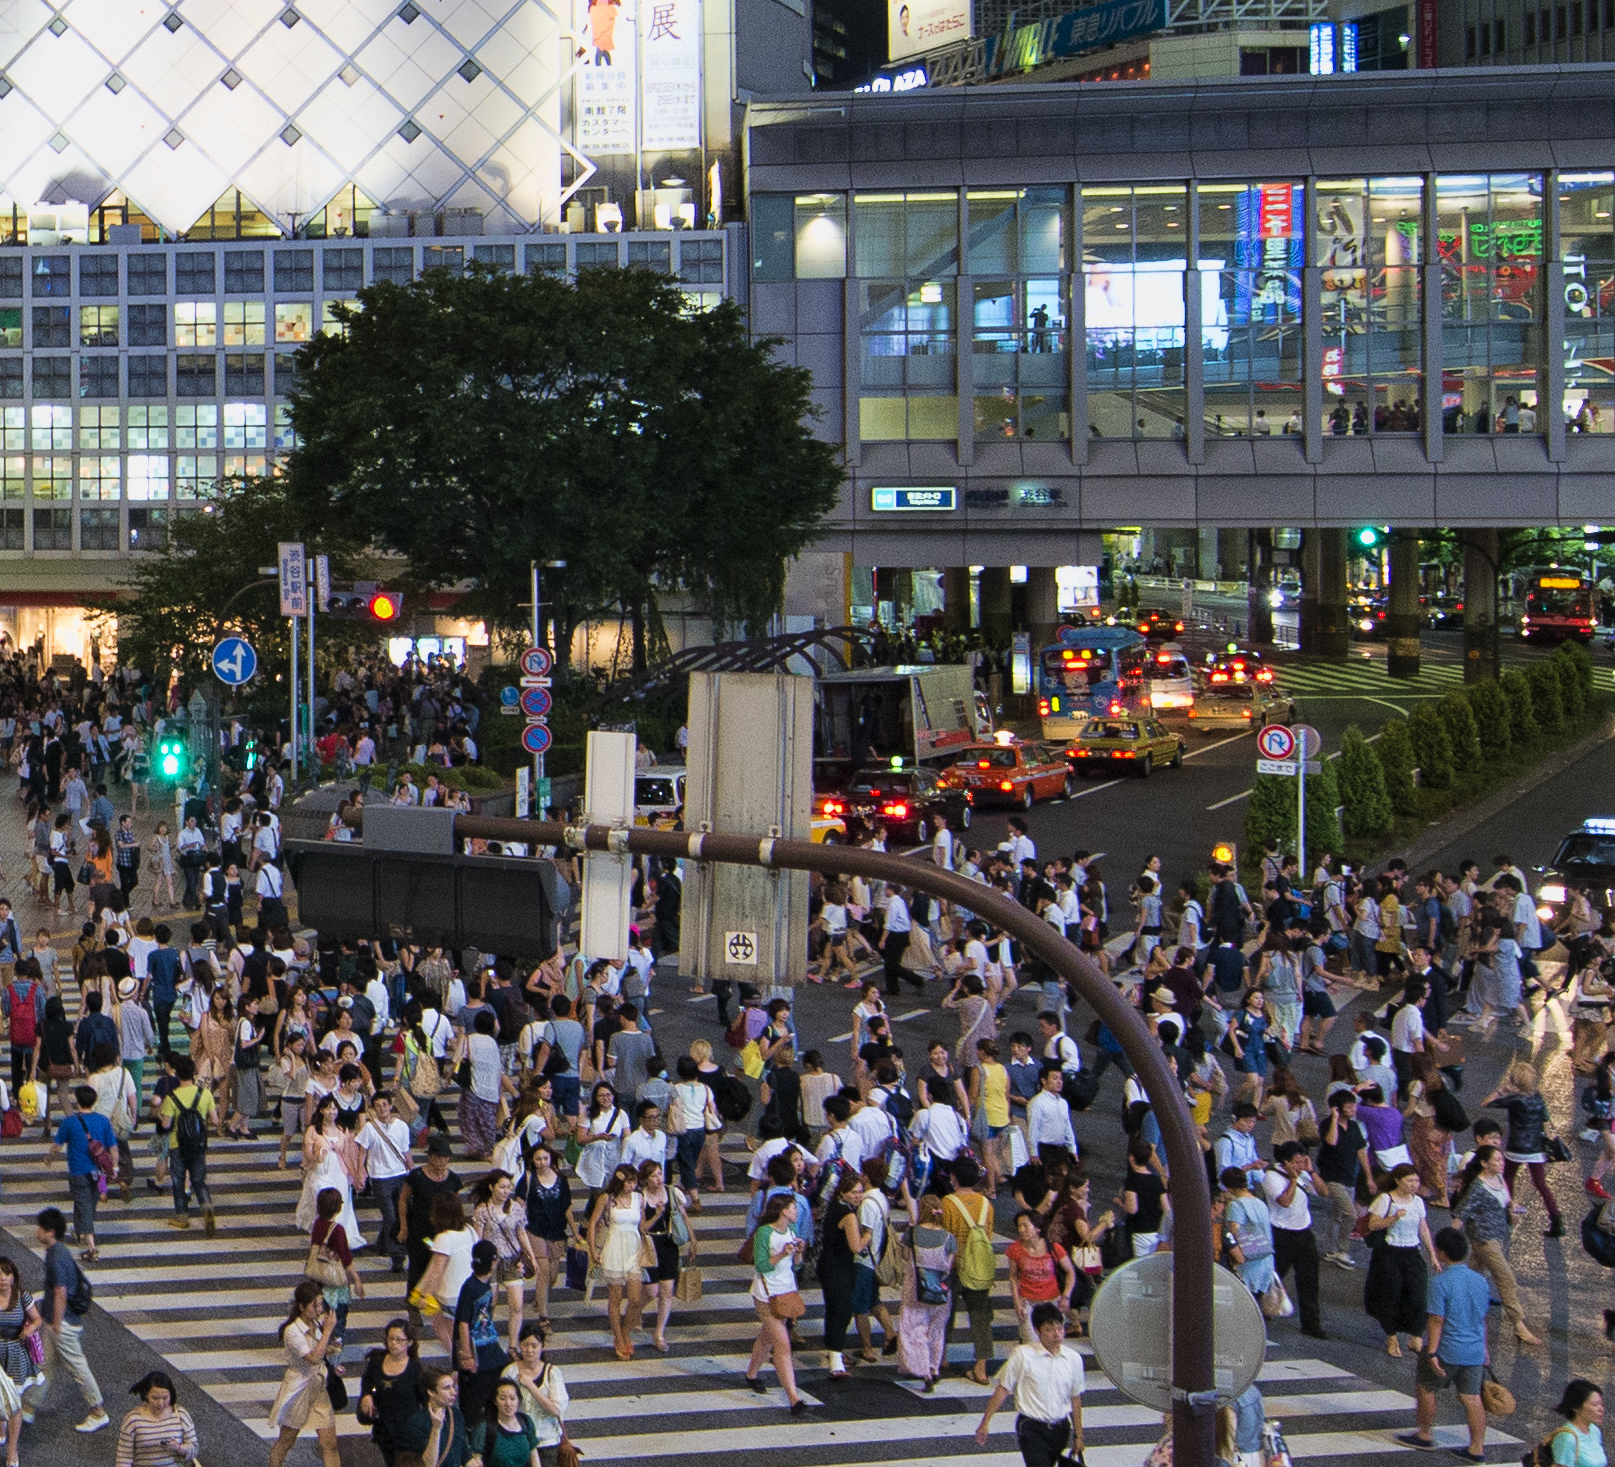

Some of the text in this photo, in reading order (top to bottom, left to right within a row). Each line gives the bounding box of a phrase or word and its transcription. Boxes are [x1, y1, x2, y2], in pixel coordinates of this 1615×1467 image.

[582, 118, 630, 127] カスタマー
[582, 128, 631, 137] センターへ
[1256, 761, 1294, 774] ここまで
